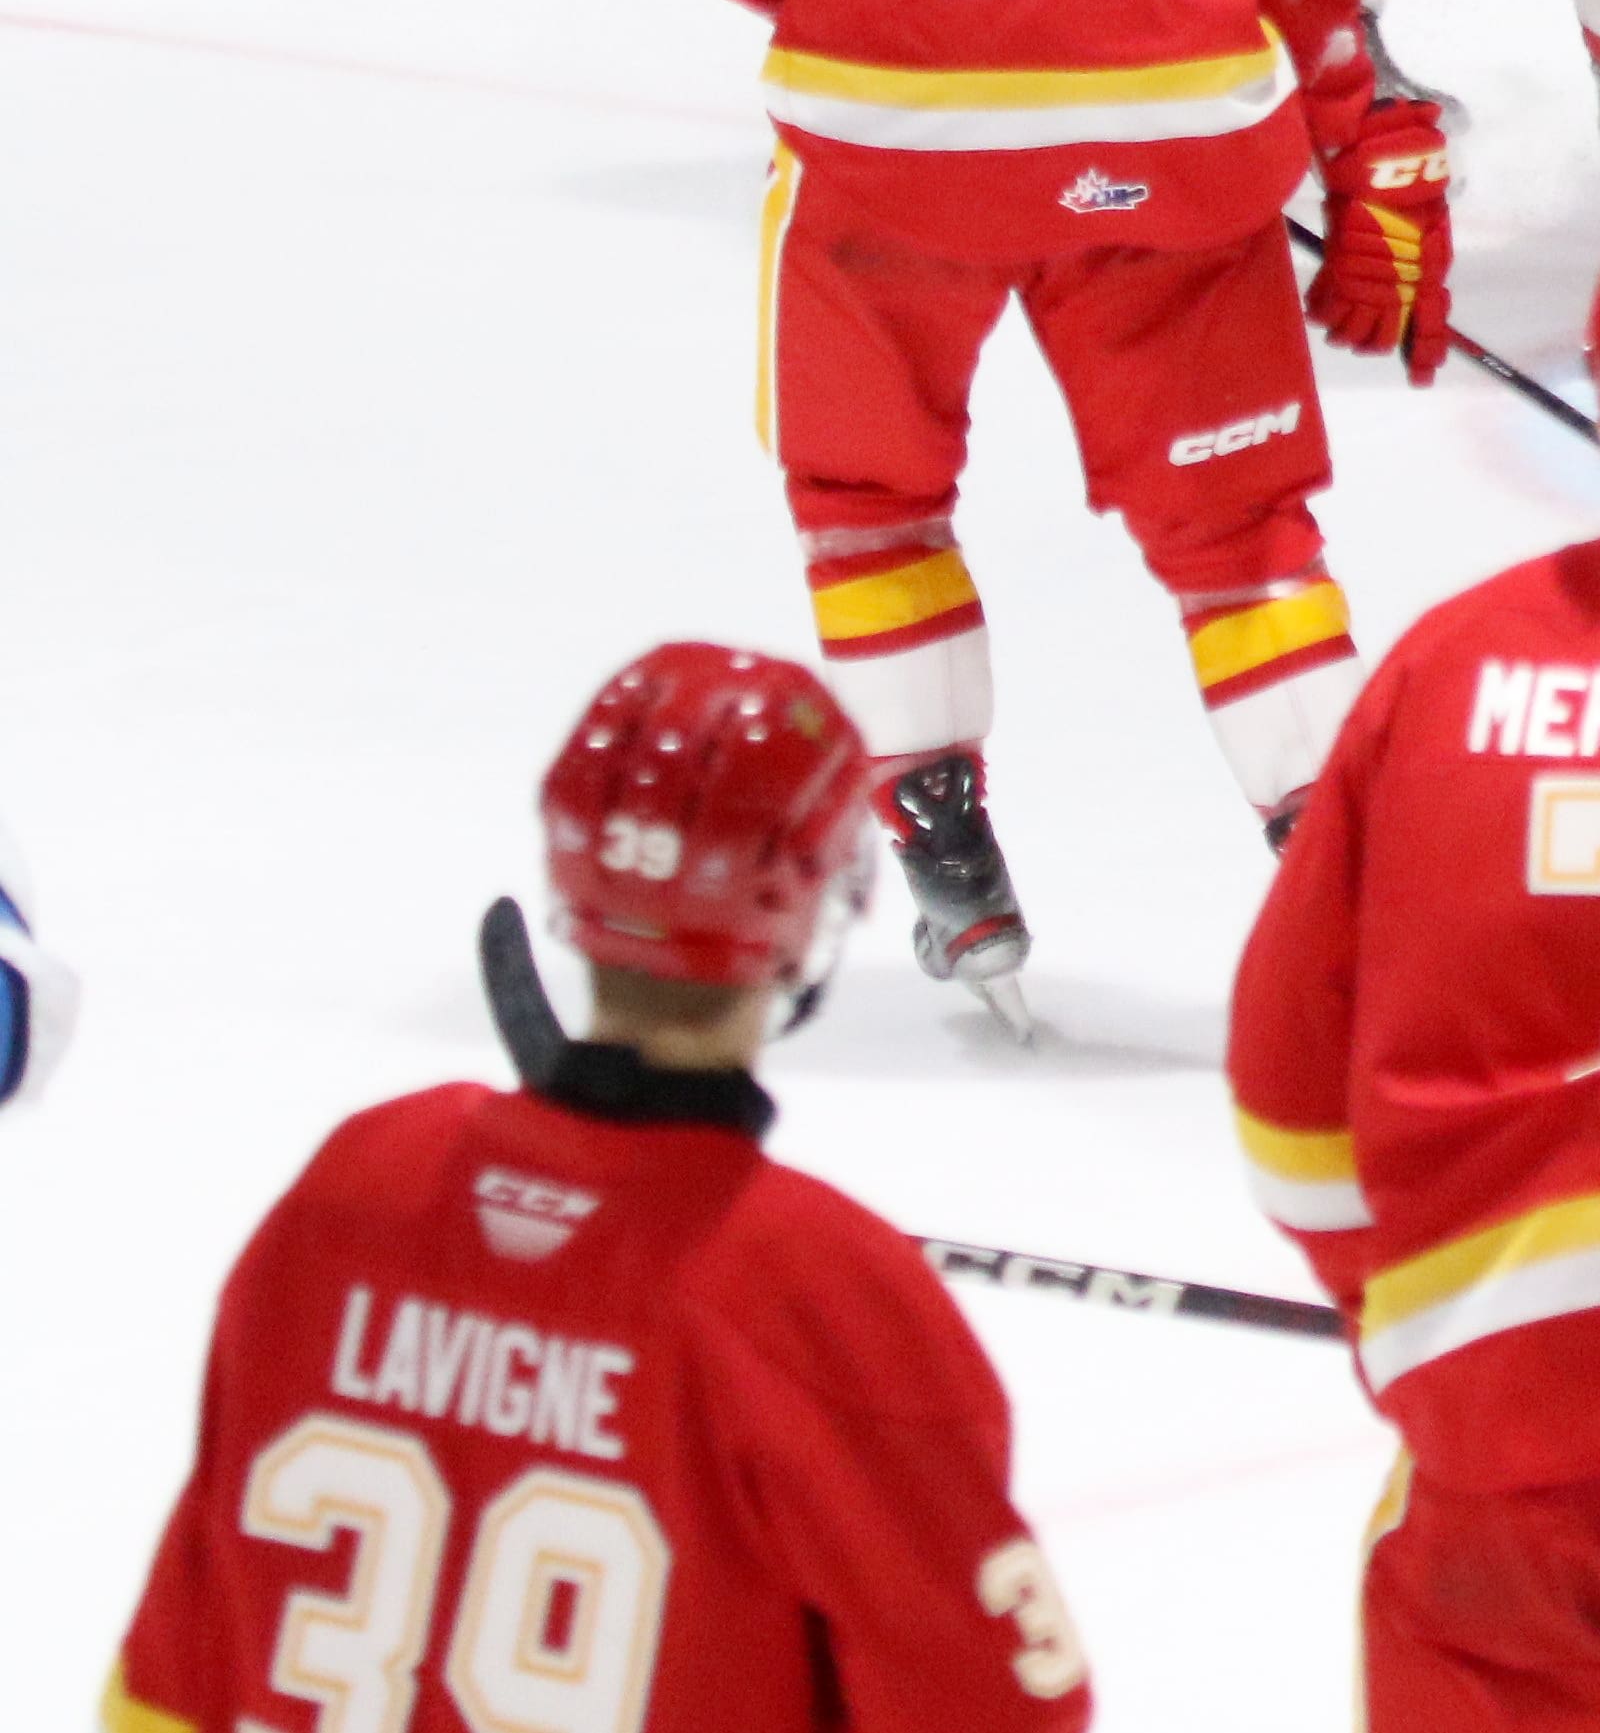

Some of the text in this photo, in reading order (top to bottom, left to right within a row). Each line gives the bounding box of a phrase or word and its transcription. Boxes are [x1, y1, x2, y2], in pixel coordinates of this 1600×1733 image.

[1168, 402, 1301, 467] CCM
[601, 814, 682, 882] 39
[920, 1238, 1186, 1318] CCM
[330, 1284, 636, 1460] LAVIGNE
[237, 1411, 673, 1733] 39
